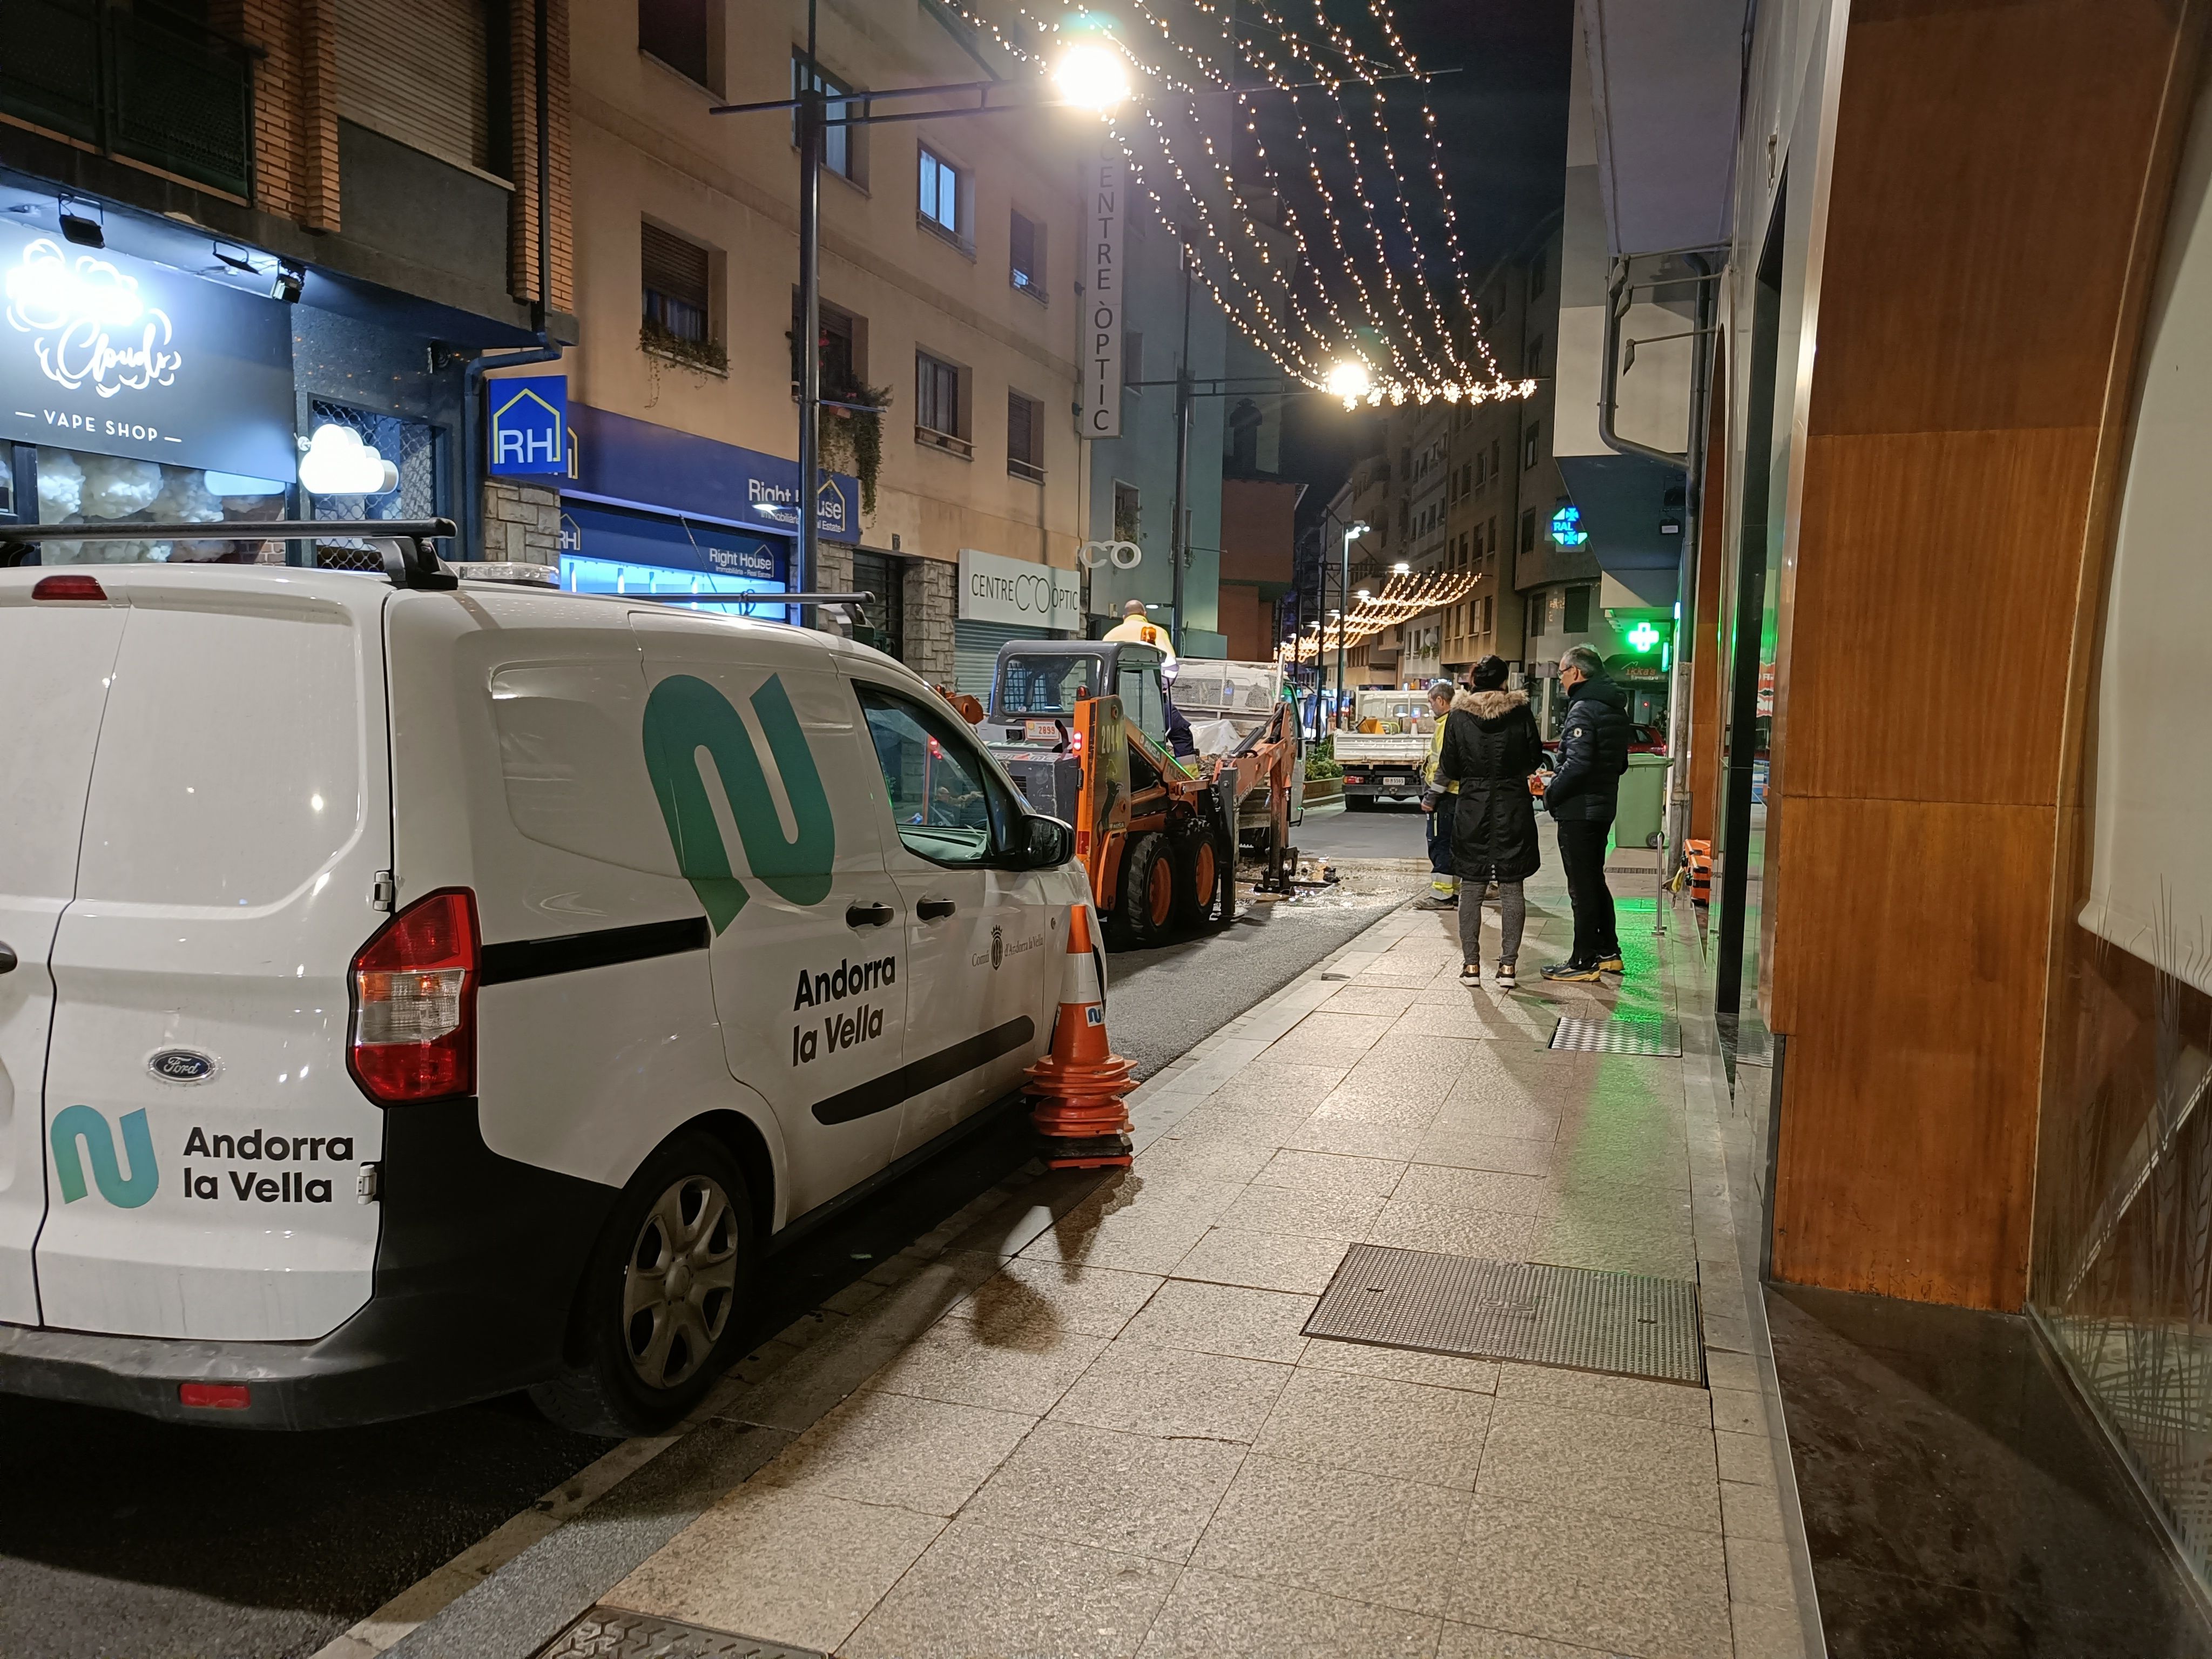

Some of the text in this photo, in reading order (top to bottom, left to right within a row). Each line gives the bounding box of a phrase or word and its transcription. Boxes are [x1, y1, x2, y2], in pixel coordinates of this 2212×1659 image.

[1093, 139, 1115, 431] CENTRE ÒPTIC
[43, 409, 158, 441] VAPE SHOP
[498, 428, 552, 464] RH
[822, 521, 841, 533] Estate
[1554, 522, 1574, 531] RAL
[709, 548, 772, 570] Right House
[972, 574, 1014, 602] CENTRE
[1052, 582, 1078, 611] ÒPTIC
[972, 950, 989, 967] Comú
[1004, 940, 1028, 957] d'Andorra
[793, 956, 895, 1011] Andorra
[793, 1003, 884, 1067] la Vella
[163, 1056, 201, 1074] Ford
[183, 1127, 354, 1161] Andorra
[184, 1167, 333, 1203] la Vella
